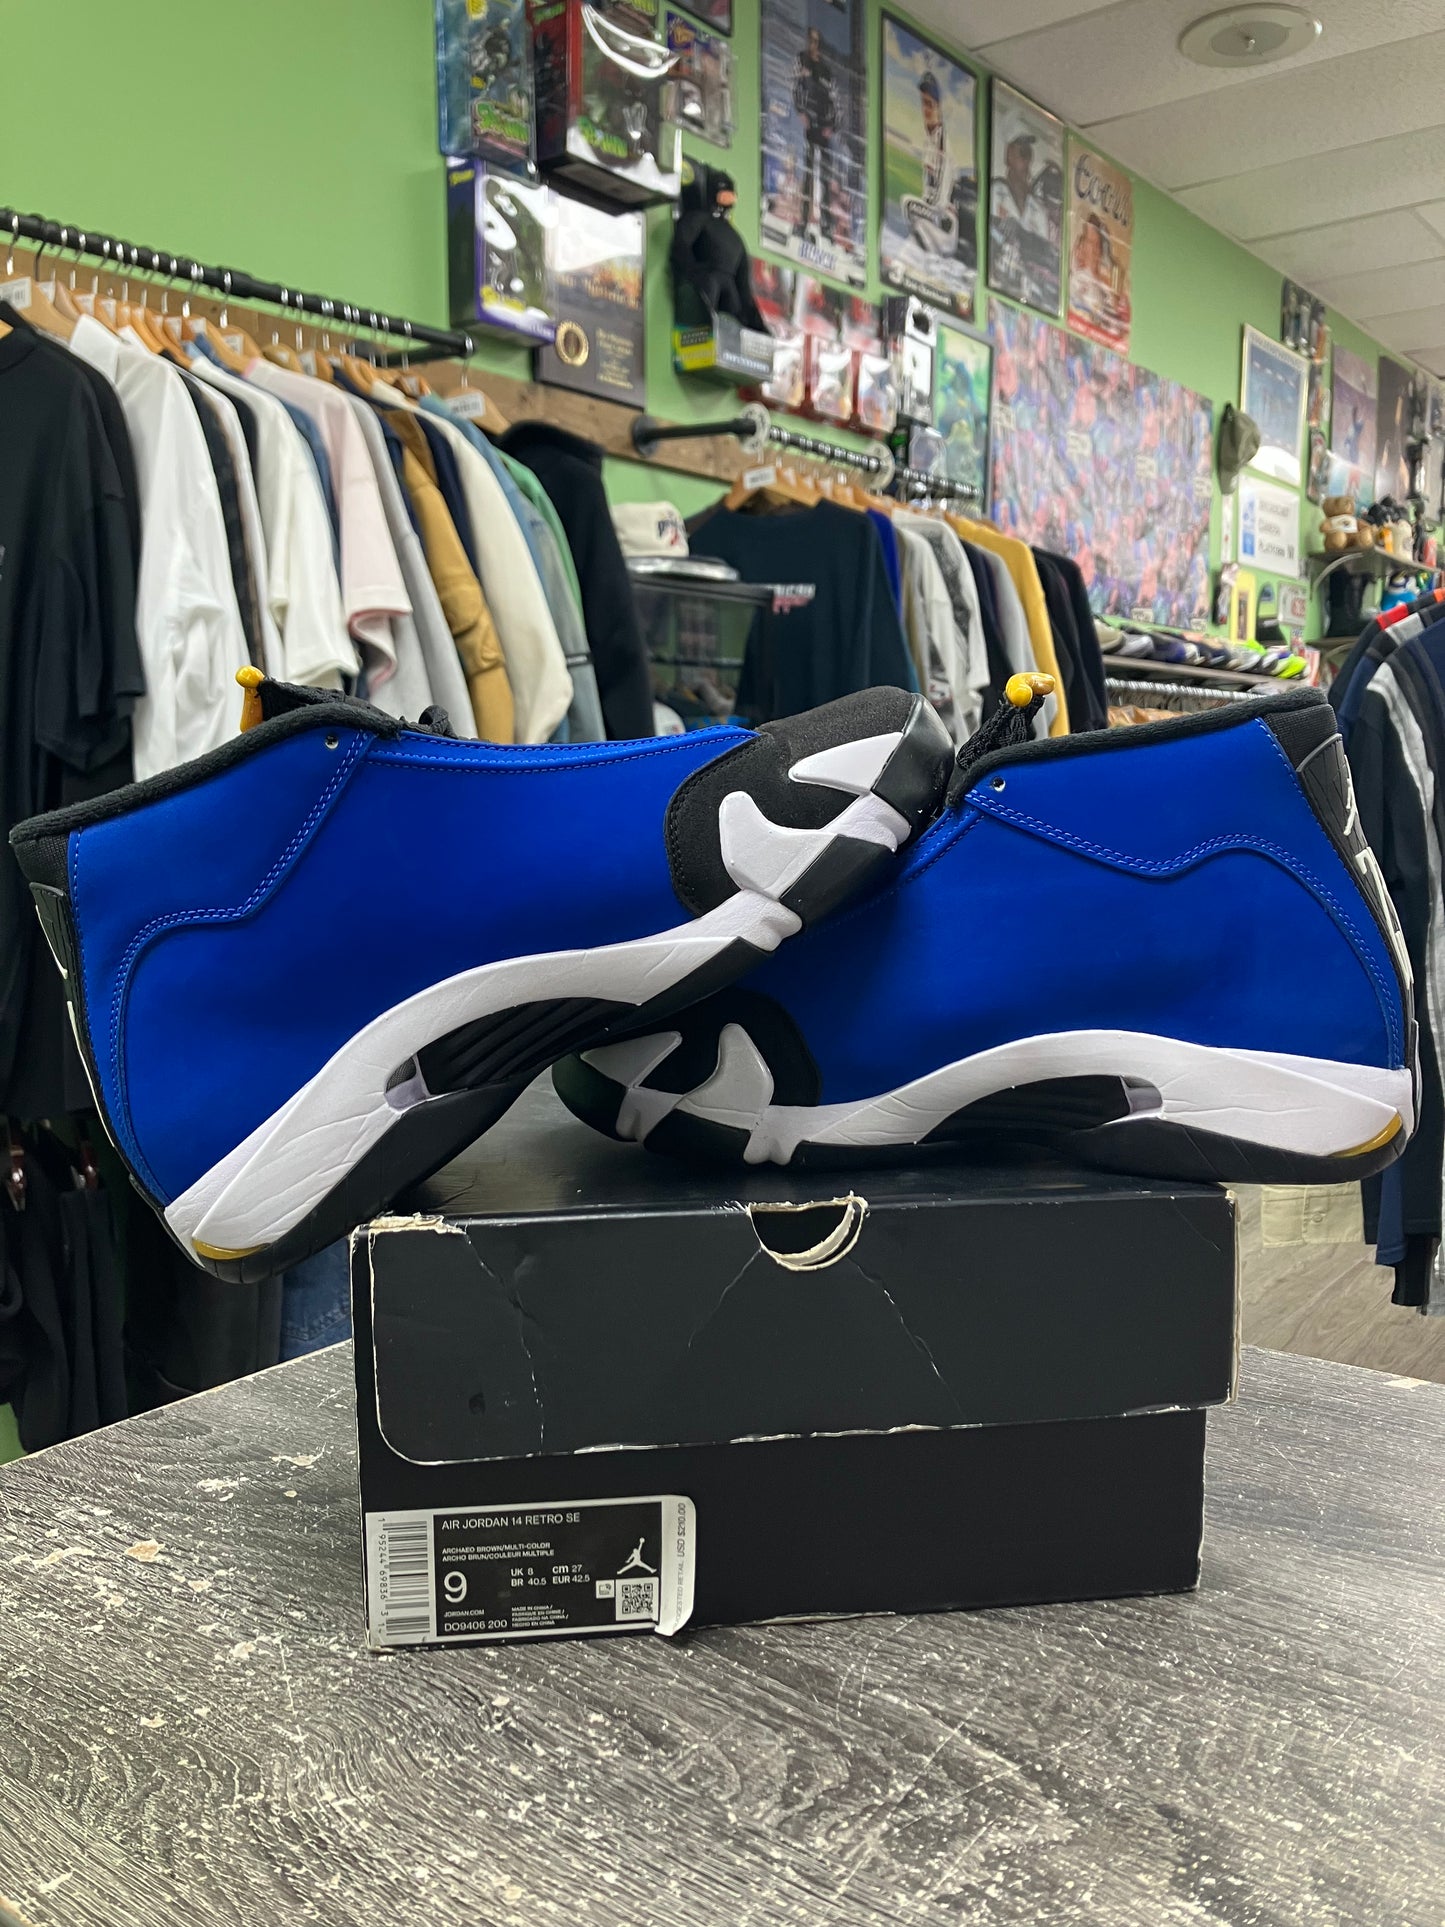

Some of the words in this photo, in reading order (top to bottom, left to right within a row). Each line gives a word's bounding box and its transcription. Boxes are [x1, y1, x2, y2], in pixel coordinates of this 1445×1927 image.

[442, 1520, 460, 1530] AIR
[462, 1517, 508, 1529] JORDAN
[512, 1517, 522, 1526] 14
[525, 1513, 563, 1525] RETRO
[566, 1512, 580, 1523] SE
[677, 1502, 686, 1537] $210.00
[442, 1546, 475, 1554] ARCHAEO
[677, 1539, 685, 1558] USD
[442, 1554, 467, 1562] ARCHO
[522, 1549, 554, 1558] MULTIPLE
[511, 1568, 524, 1577] UK
[527, 1567, 534, 1576] 8
[552, 1565, 569, 1574] cm
[571, 1564, 582, 1573] 27
[511, 1578, 524, 1587] BR
[528, 1577, 546, 1586] 40.5
[552, 1575, 571, 1584] EUR
[572, 1574, 590, 1583] 42.5
[444, 1571, 468, 1603] 9
[444, 1609, 485, 1618] JORDAN.COM
[488, 1619, 508, 1629] 200
